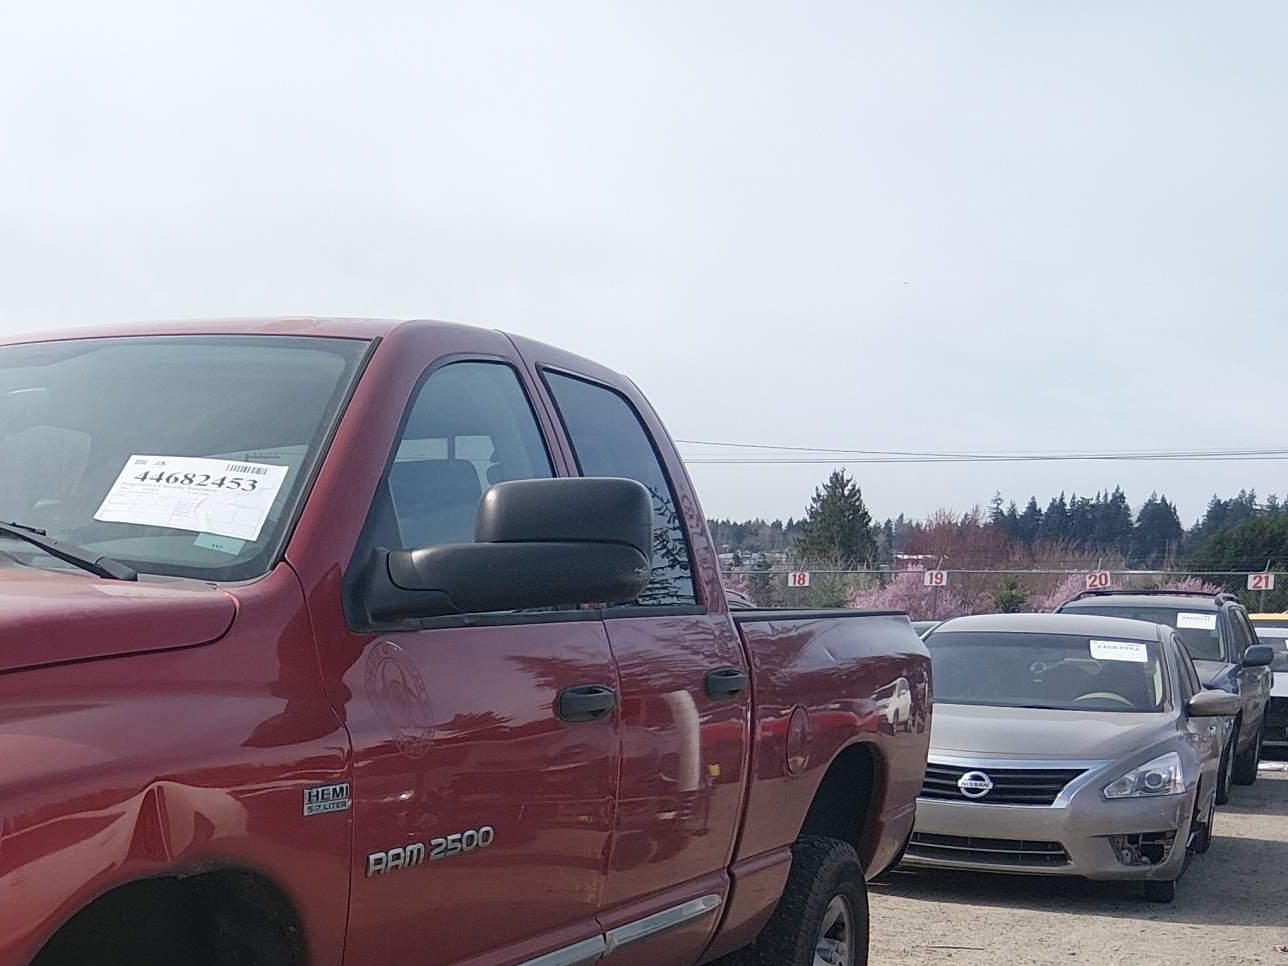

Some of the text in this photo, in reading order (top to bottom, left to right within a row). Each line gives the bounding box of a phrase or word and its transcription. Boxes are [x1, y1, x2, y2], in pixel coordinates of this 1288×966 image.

[134, 470, 259, 492] 44682453
[792, 574, 806, 585] 18
[929, 572, 944, 585] 19
[1088, 574, 1109, 587] 20
[1253, 575, 1270, 589] 21
[307, 785, 349, 802] HEMI
[323, 800, 347, 810] LITER
[366, 826, 494, 878] RAM 2500
